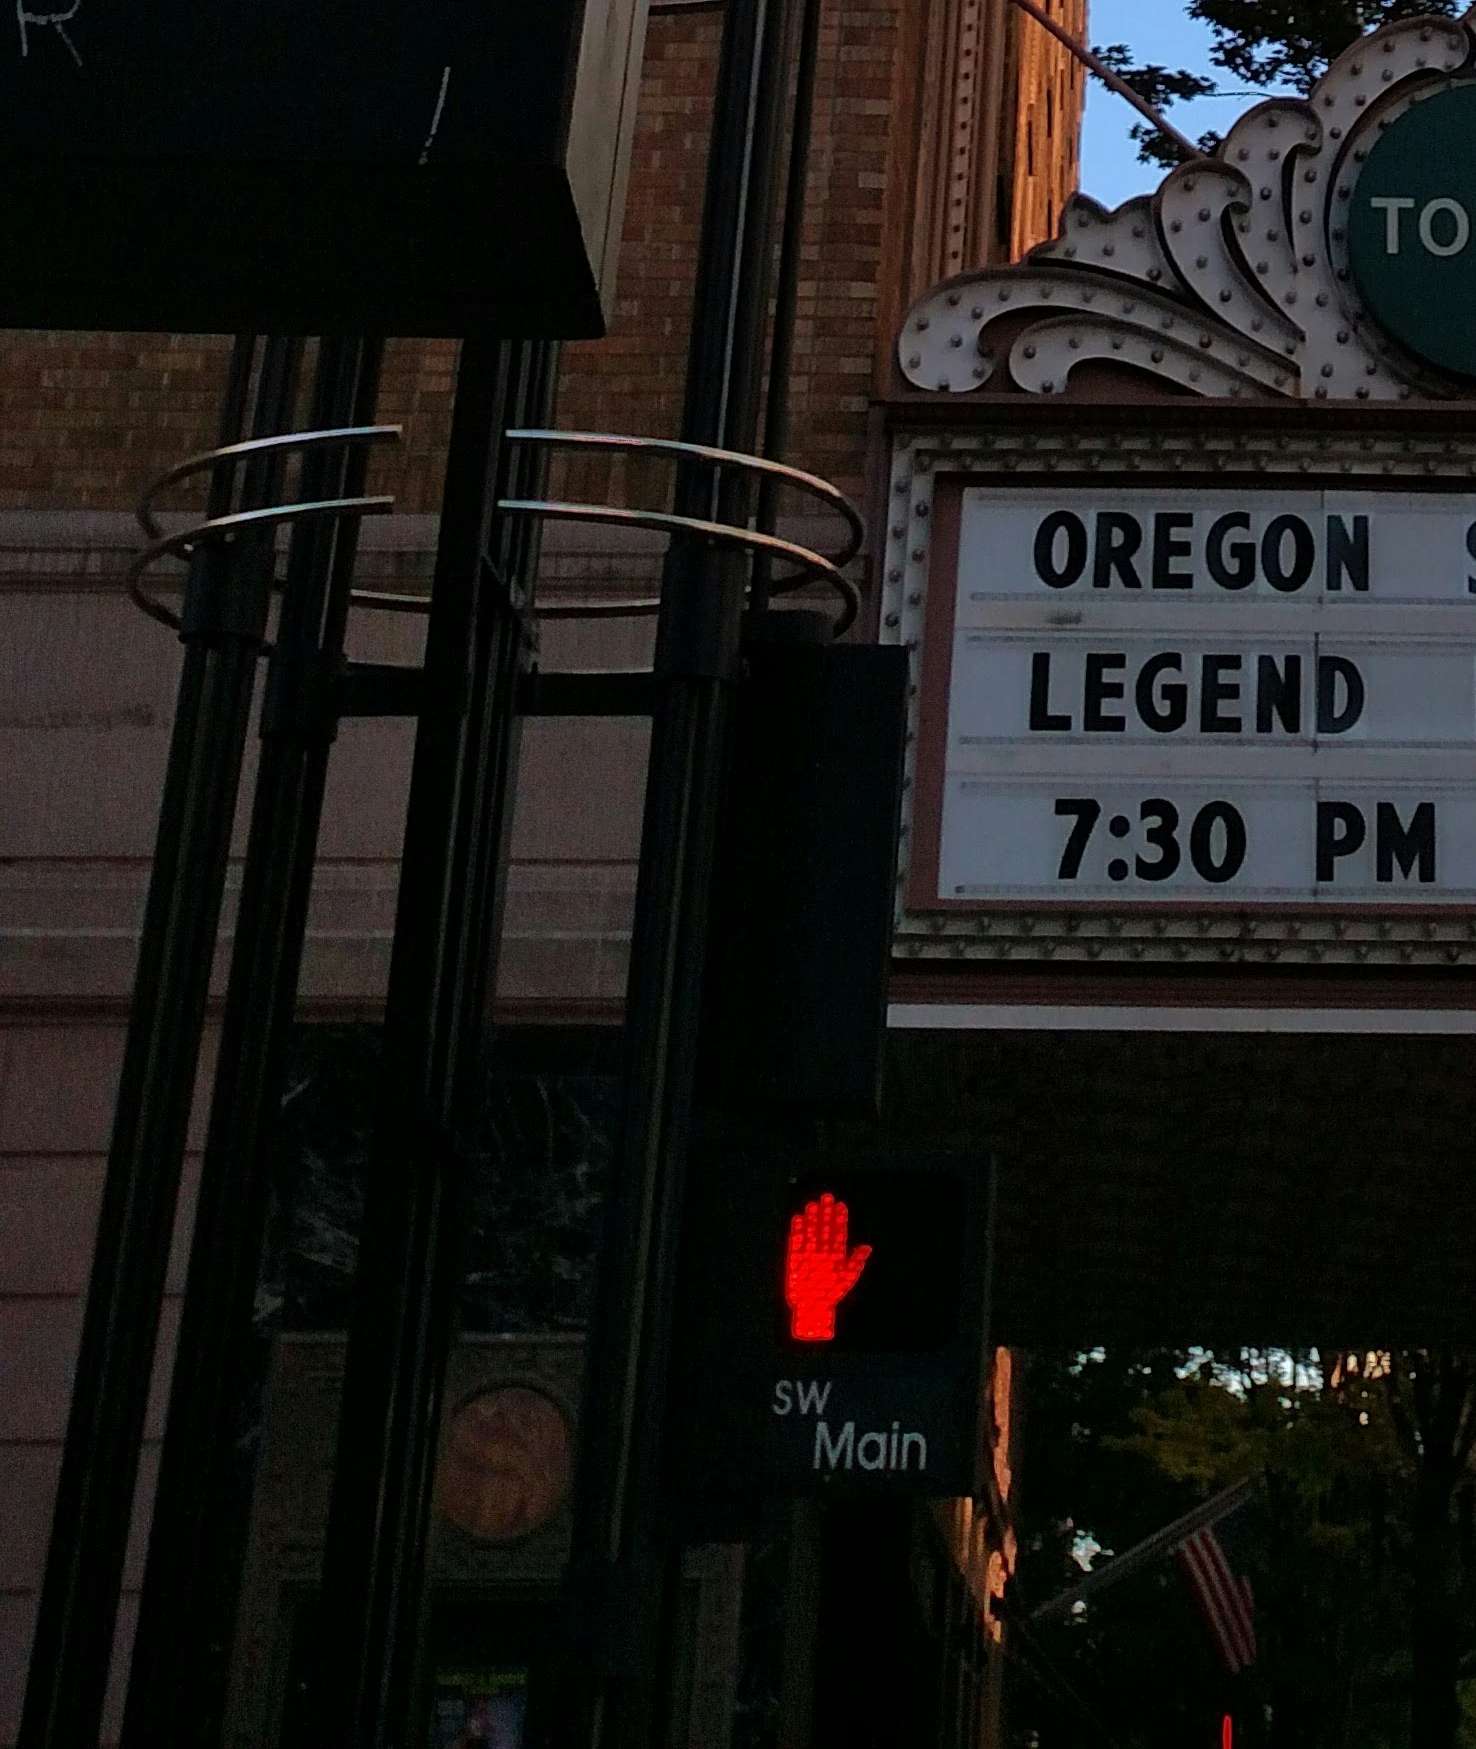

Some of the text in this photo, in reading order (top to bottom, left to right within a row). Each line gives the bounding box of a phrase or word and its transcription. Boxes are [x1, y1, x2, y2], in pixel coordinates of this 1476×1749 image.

[1033, 509, 1370, 593] OREGON
[1029, 651, 1365, 734] LEGEND
[1054, 798, 1247, 883] 7:30
[1316, 801, 1437, 883] PM
[772, 1379, 833, 1416] SW
[813, 1420, 928, 1471] Main
